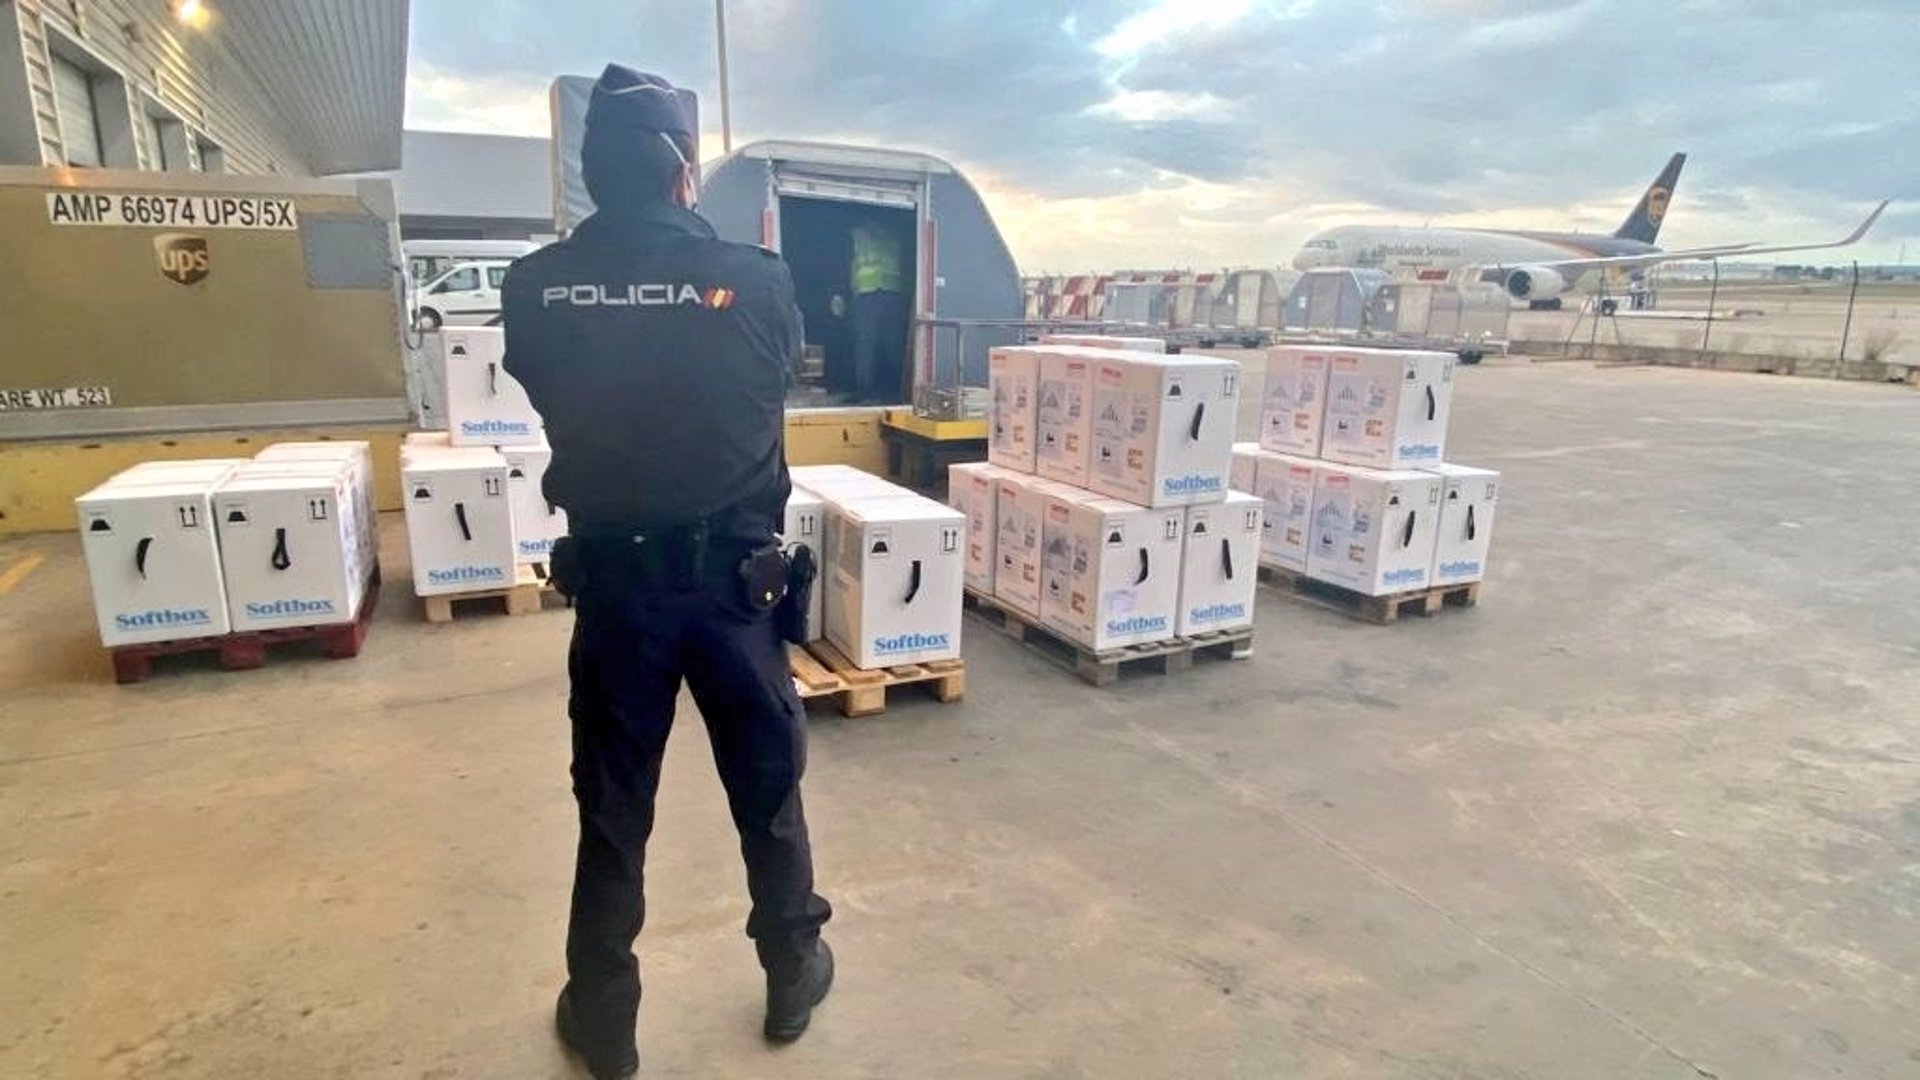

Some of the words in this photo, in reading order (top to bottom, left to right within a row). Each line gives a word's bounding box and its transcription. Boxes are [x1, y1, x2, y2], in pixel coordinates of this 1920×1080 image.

[53, 194, 112, 222] AMP
[121, 196, 195, 224] 66974
[203, 199, 294, 226] UPS/5X
[161, 250, 208, 280] ups
[543, 283, 701, 308] POLICIA
[461, 420, 530, 433] Softbox
[1164, 475, 1220, 491] Softbox
[428, 566, 504, 583] Softbox
[246, 599, 333, 617] Softbox
[1190, 603, 1245, 621] Softbox
[116, 608, 209, 628] Softbox
[1107, 615, 1167, 634] Softbox
[874, 632, 949, 651] Softbox
